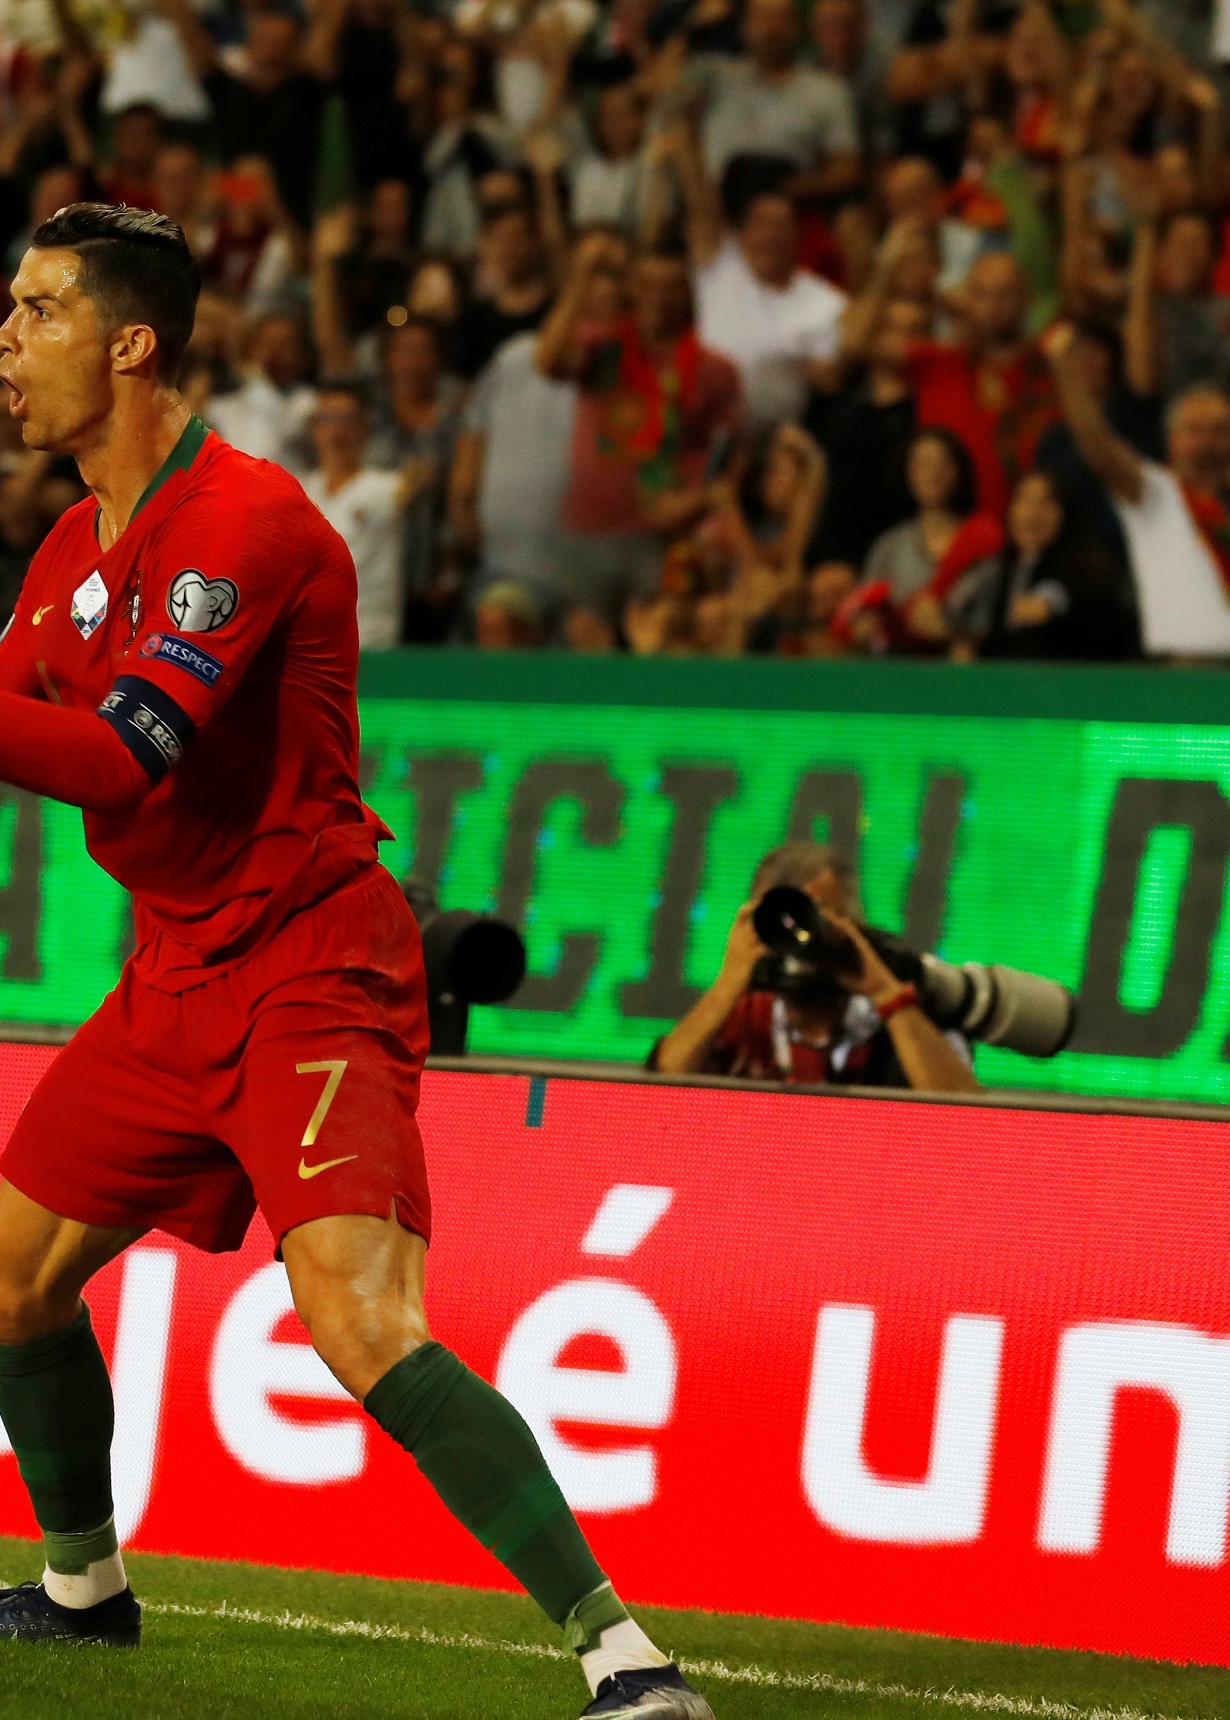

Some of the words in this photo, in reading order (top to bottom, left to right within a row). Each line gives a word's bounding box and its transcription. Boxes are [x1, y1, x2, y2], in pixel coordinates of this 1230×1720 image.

[160, 641, 221, 680] RESPECT
[295, 1060, 348, 1147] 7
[494, 1182, 677, 1515] é
